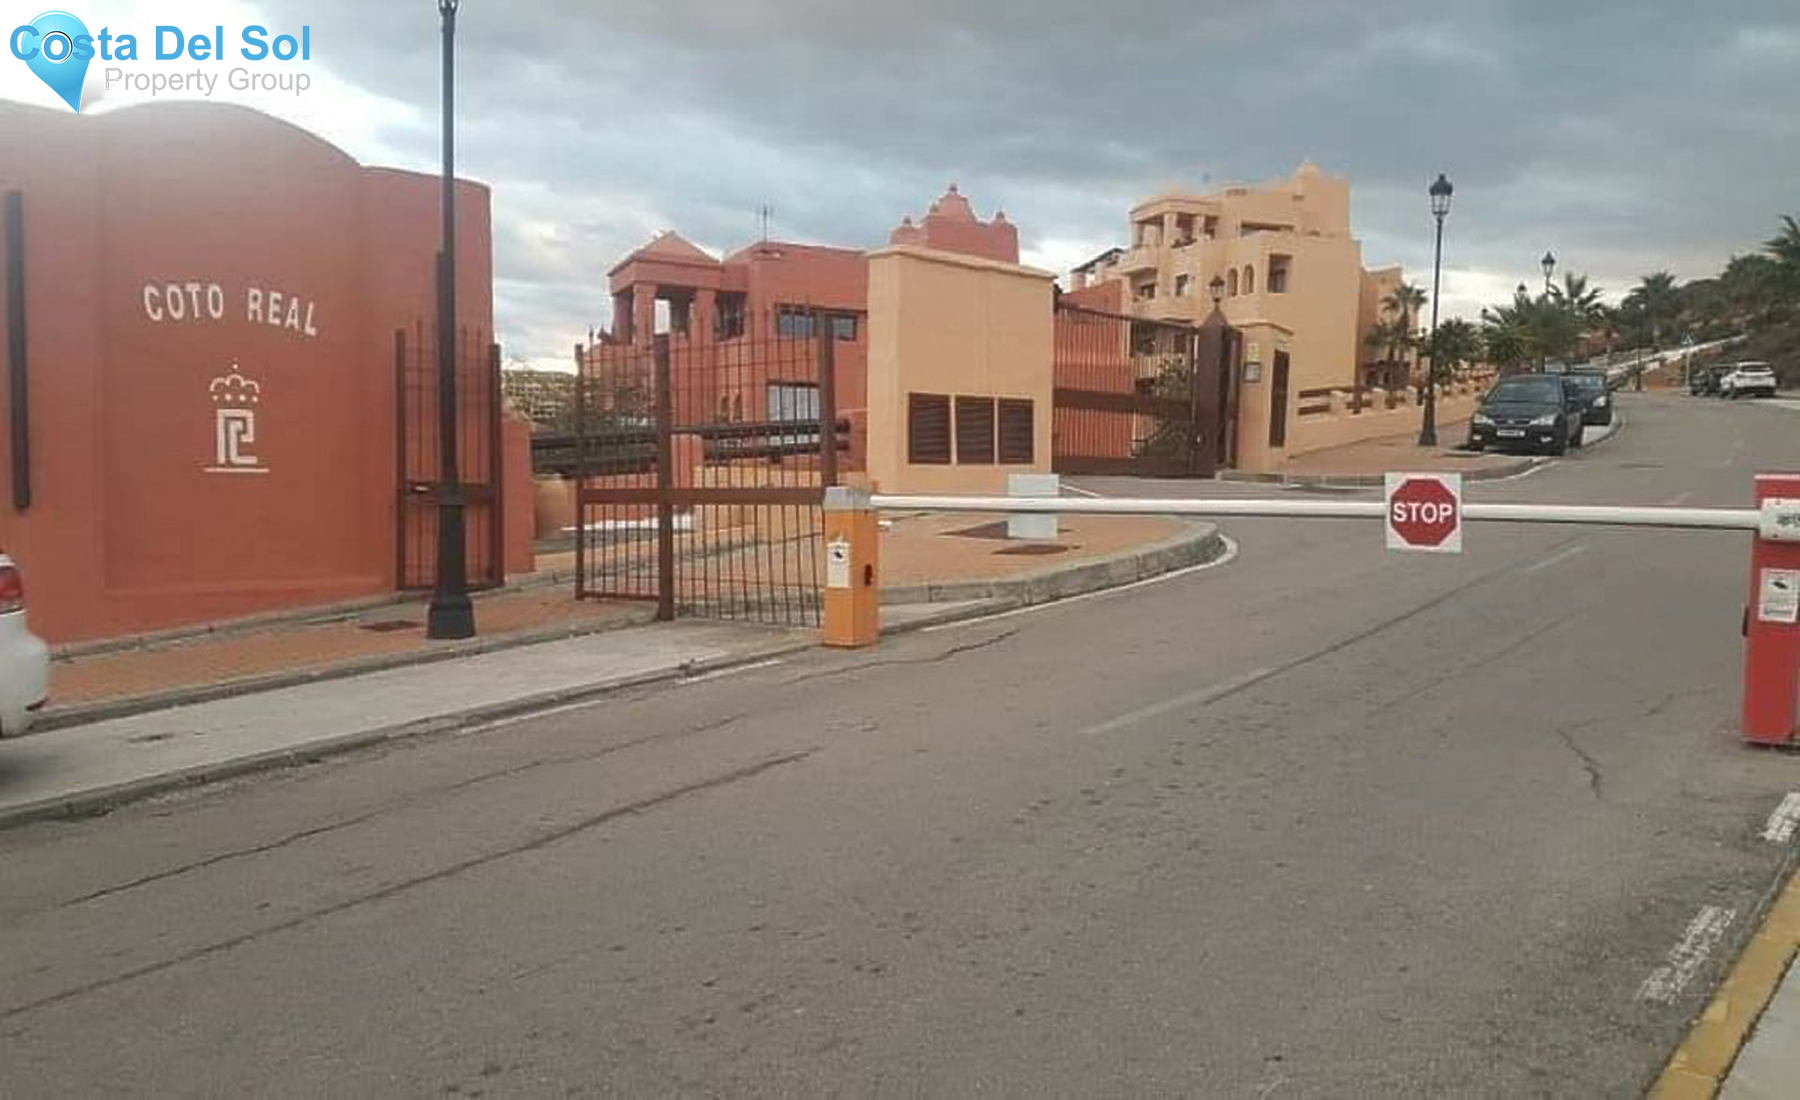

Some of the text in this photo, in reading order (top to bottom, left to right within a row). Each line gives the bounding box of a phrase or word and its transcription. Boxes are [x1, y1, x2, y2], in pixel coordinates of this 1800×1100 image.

[143, 283, 317, 336] COTO REAL
[1393, 502, 1453, 524] STOP
